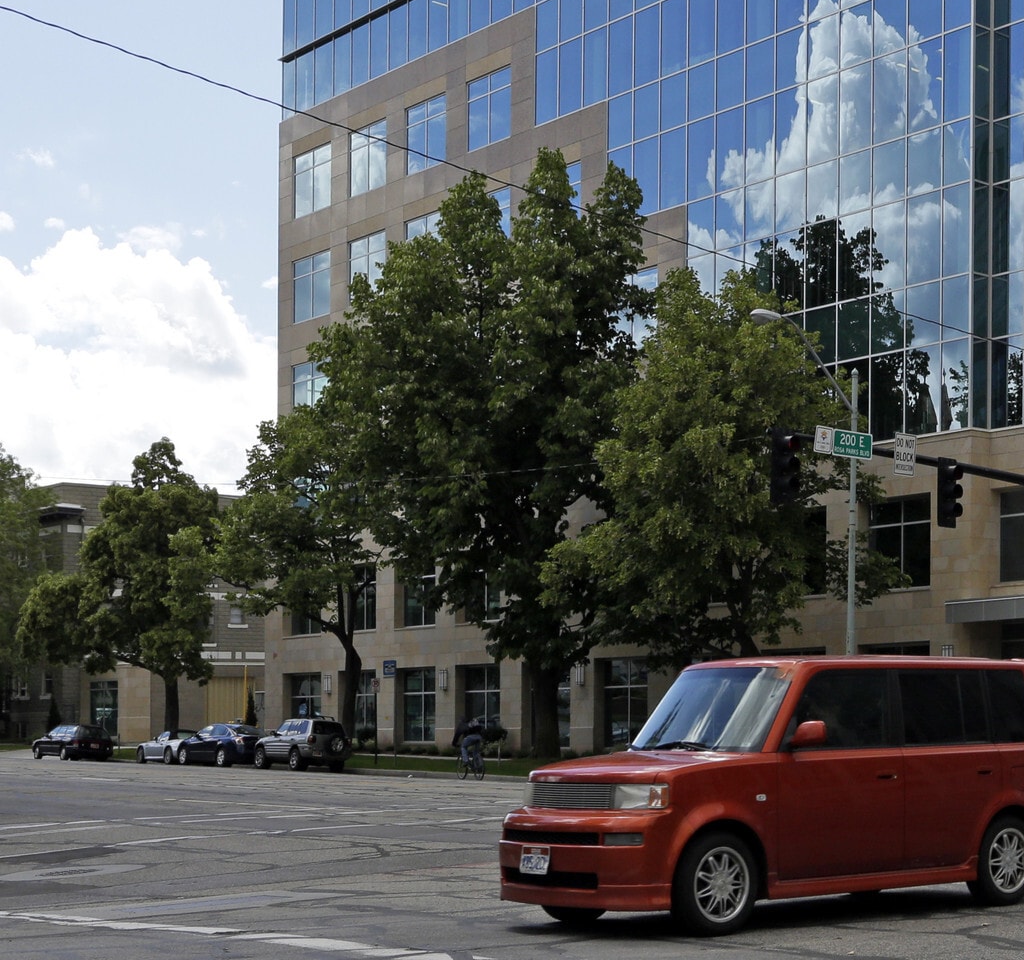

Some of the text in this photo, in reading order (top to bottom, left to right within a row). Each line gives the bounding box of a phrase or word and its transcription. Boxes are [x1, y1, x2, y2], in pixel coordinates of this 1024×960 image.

[840, 433, 856, 446] 200
[896, 438, 915, 449] DO NOT
[846, 448, 859, 456] PARKS
[895, 451, 914, 462] BLOCK
